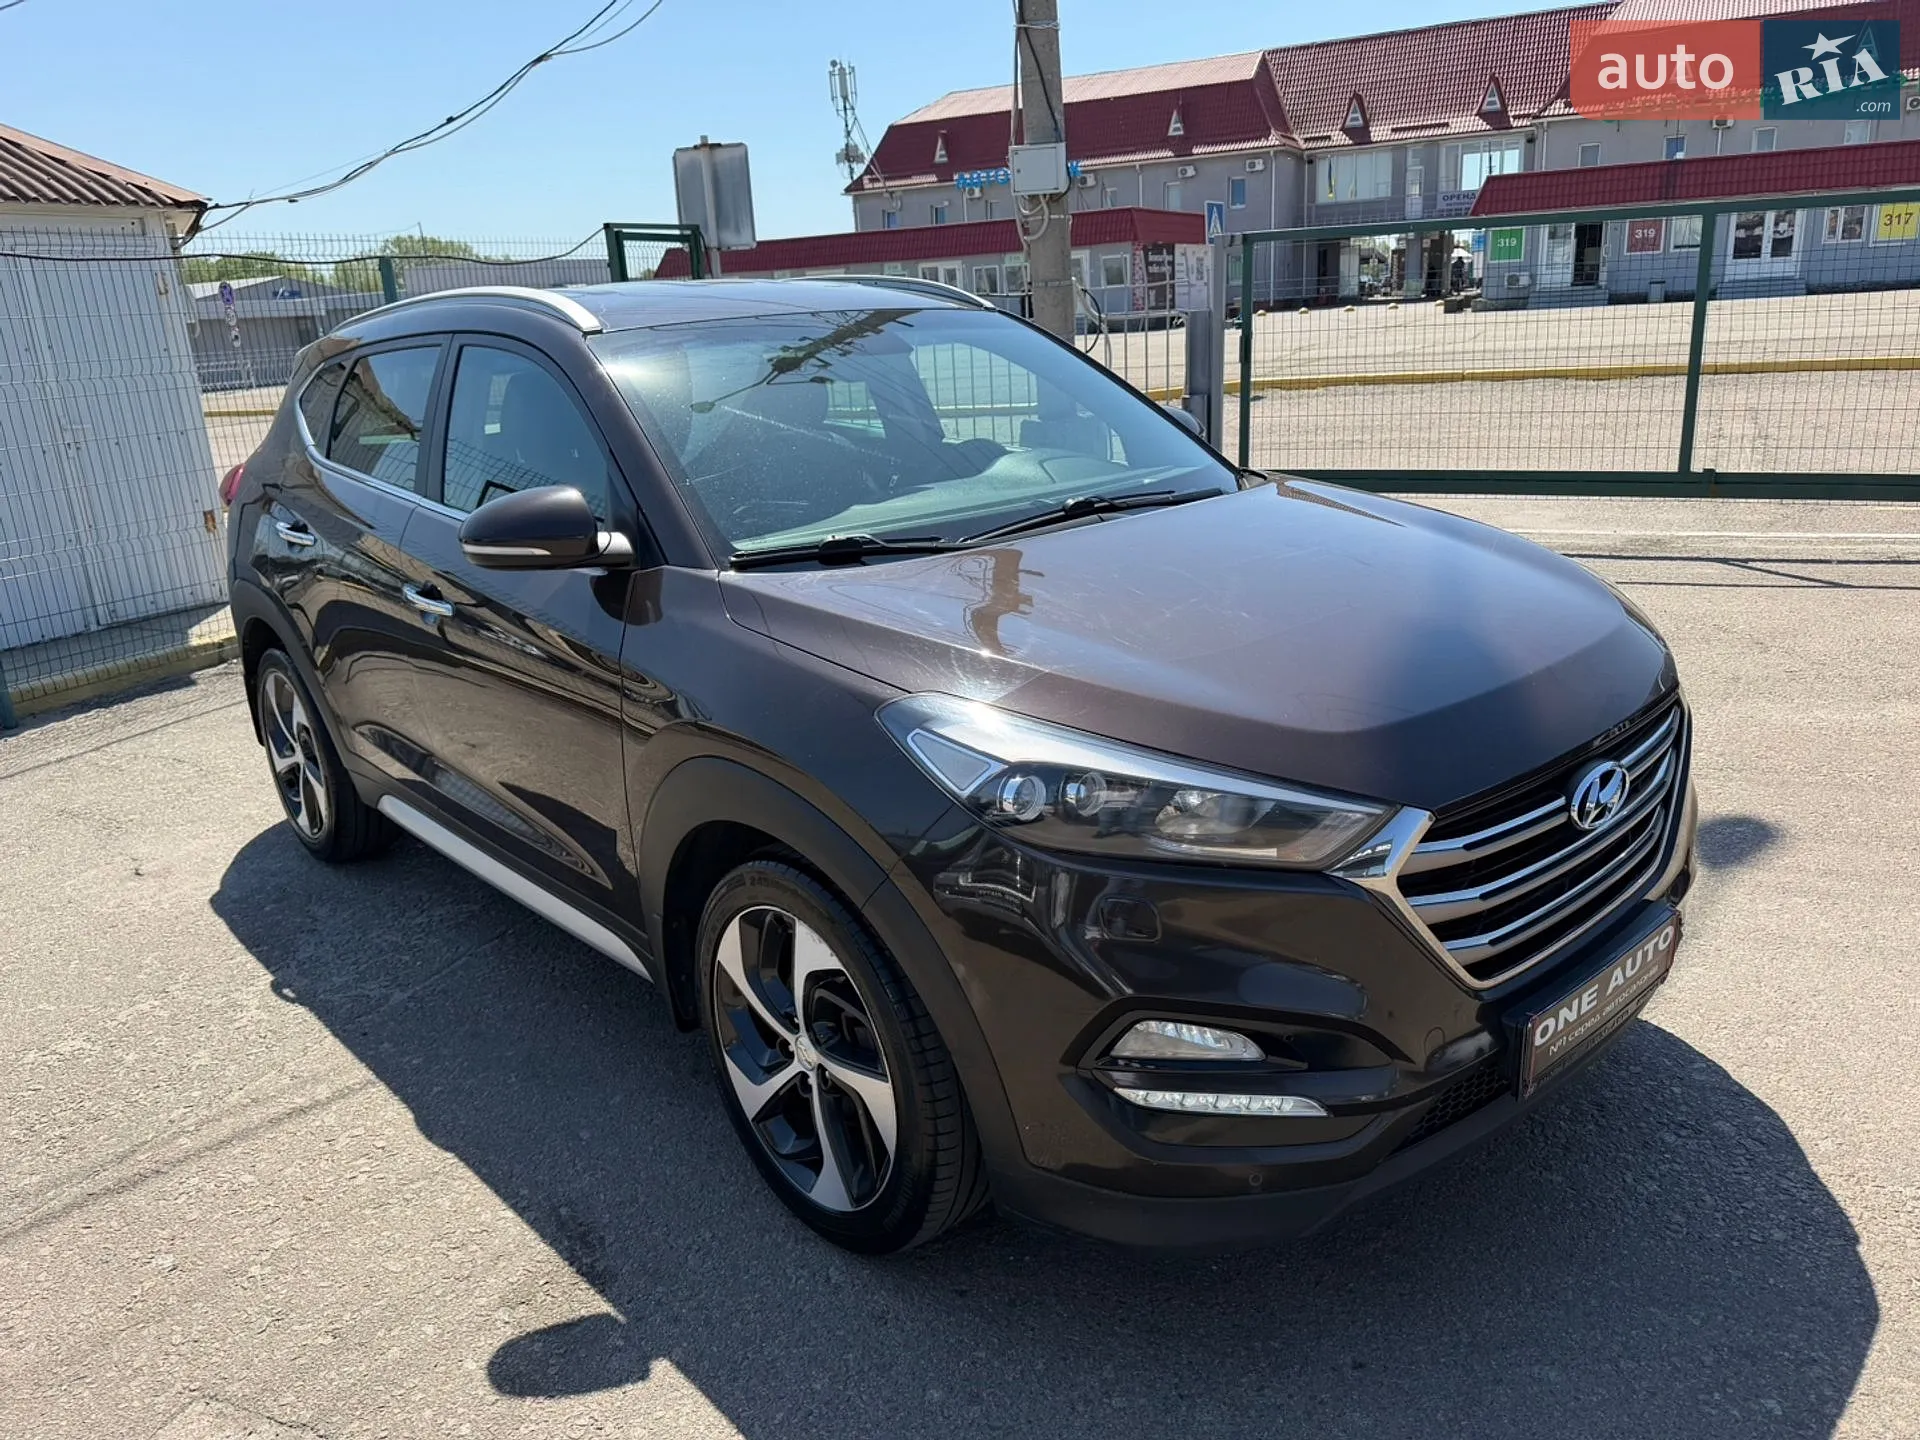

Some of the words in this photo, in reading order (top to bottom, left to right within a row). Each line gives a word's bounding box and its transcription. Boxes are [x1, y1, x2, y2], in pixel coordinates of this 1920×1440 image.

[1442, 192, 1476, 202] ОРЕНД
[1883, 212, 1914, 227] 317
[1634, 228, 1656, 239] 319
[1497, 237, 1517, 247] 319
[1534, 984, 1599, 1046] ONE
[1605, 925, 1675, 997] AUTO
